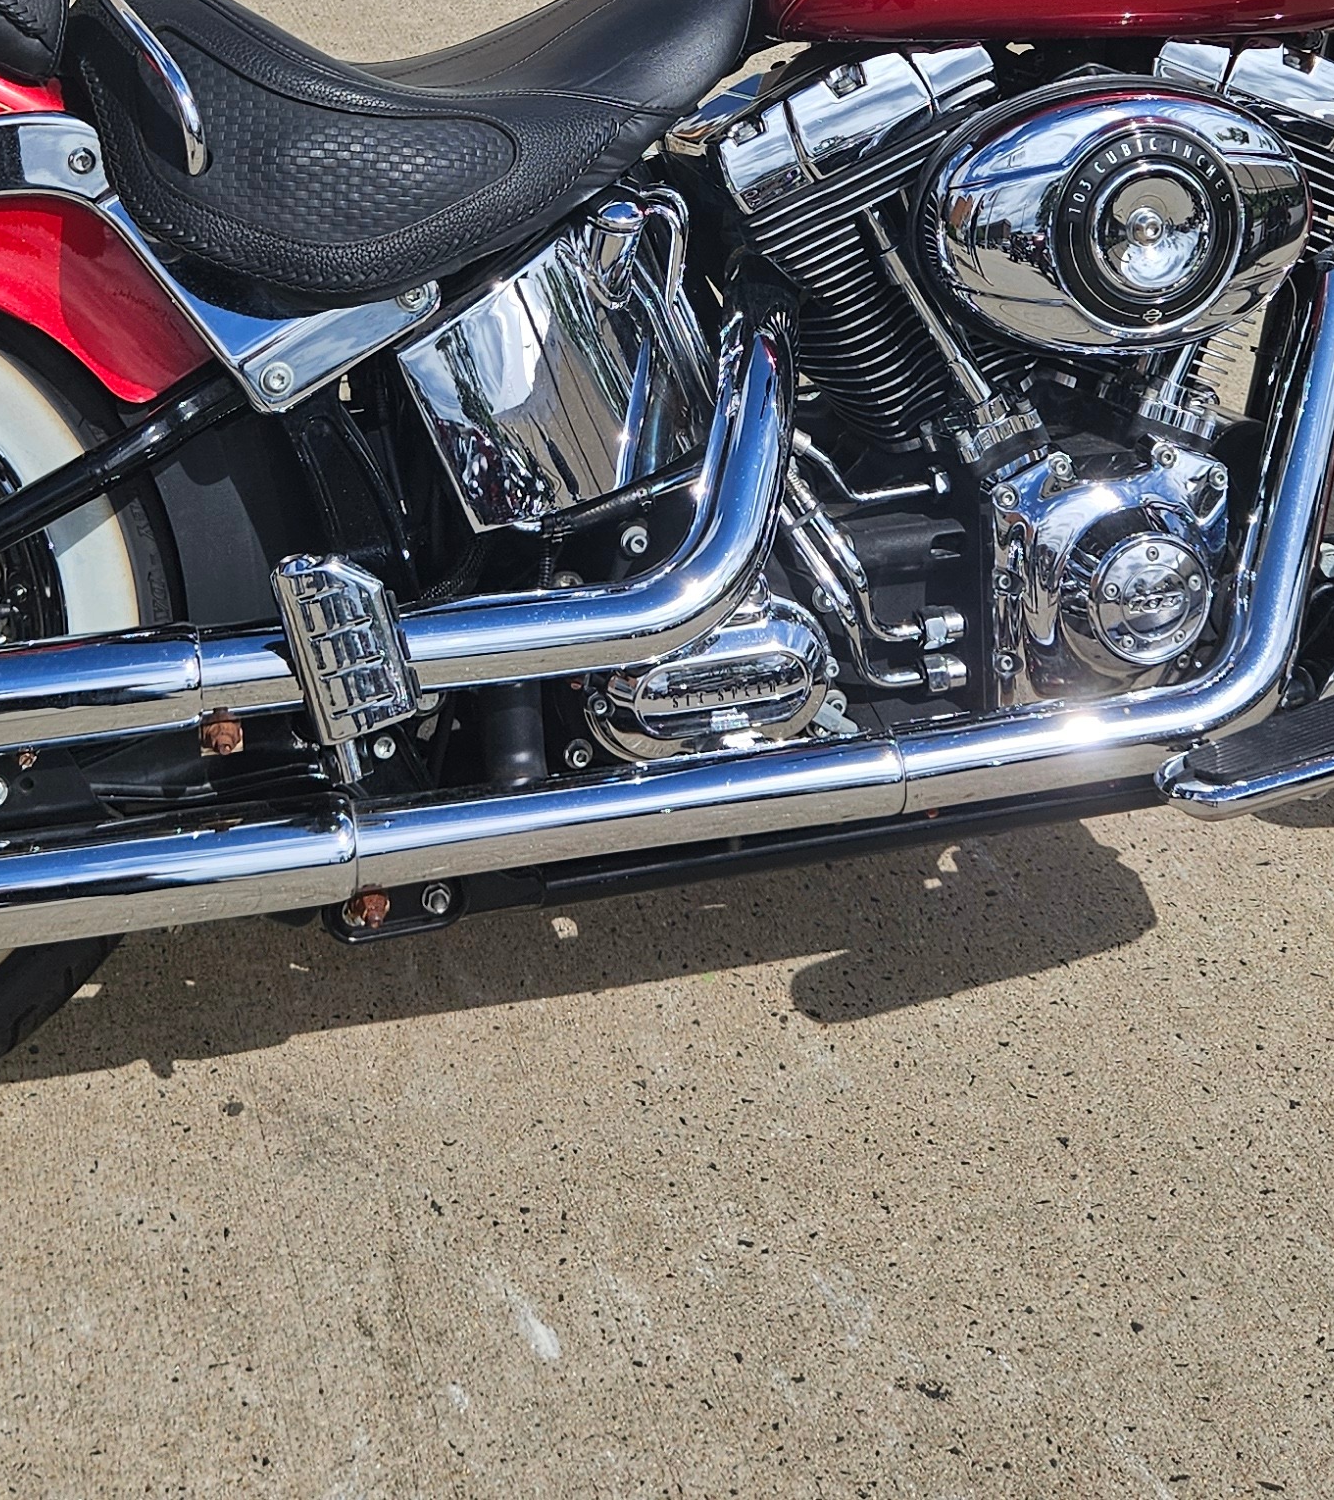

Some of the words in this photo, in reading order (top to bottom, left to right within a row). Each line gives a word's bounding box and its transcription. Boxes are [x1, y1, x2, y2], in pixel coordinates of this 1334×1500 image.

[1068, 178, 1093, 214] 103
[1093, 136, 1159, 175] CUBIC
[1171, 139, 1231, 203] INCHES
[671, 691, 705, 709] SIX
